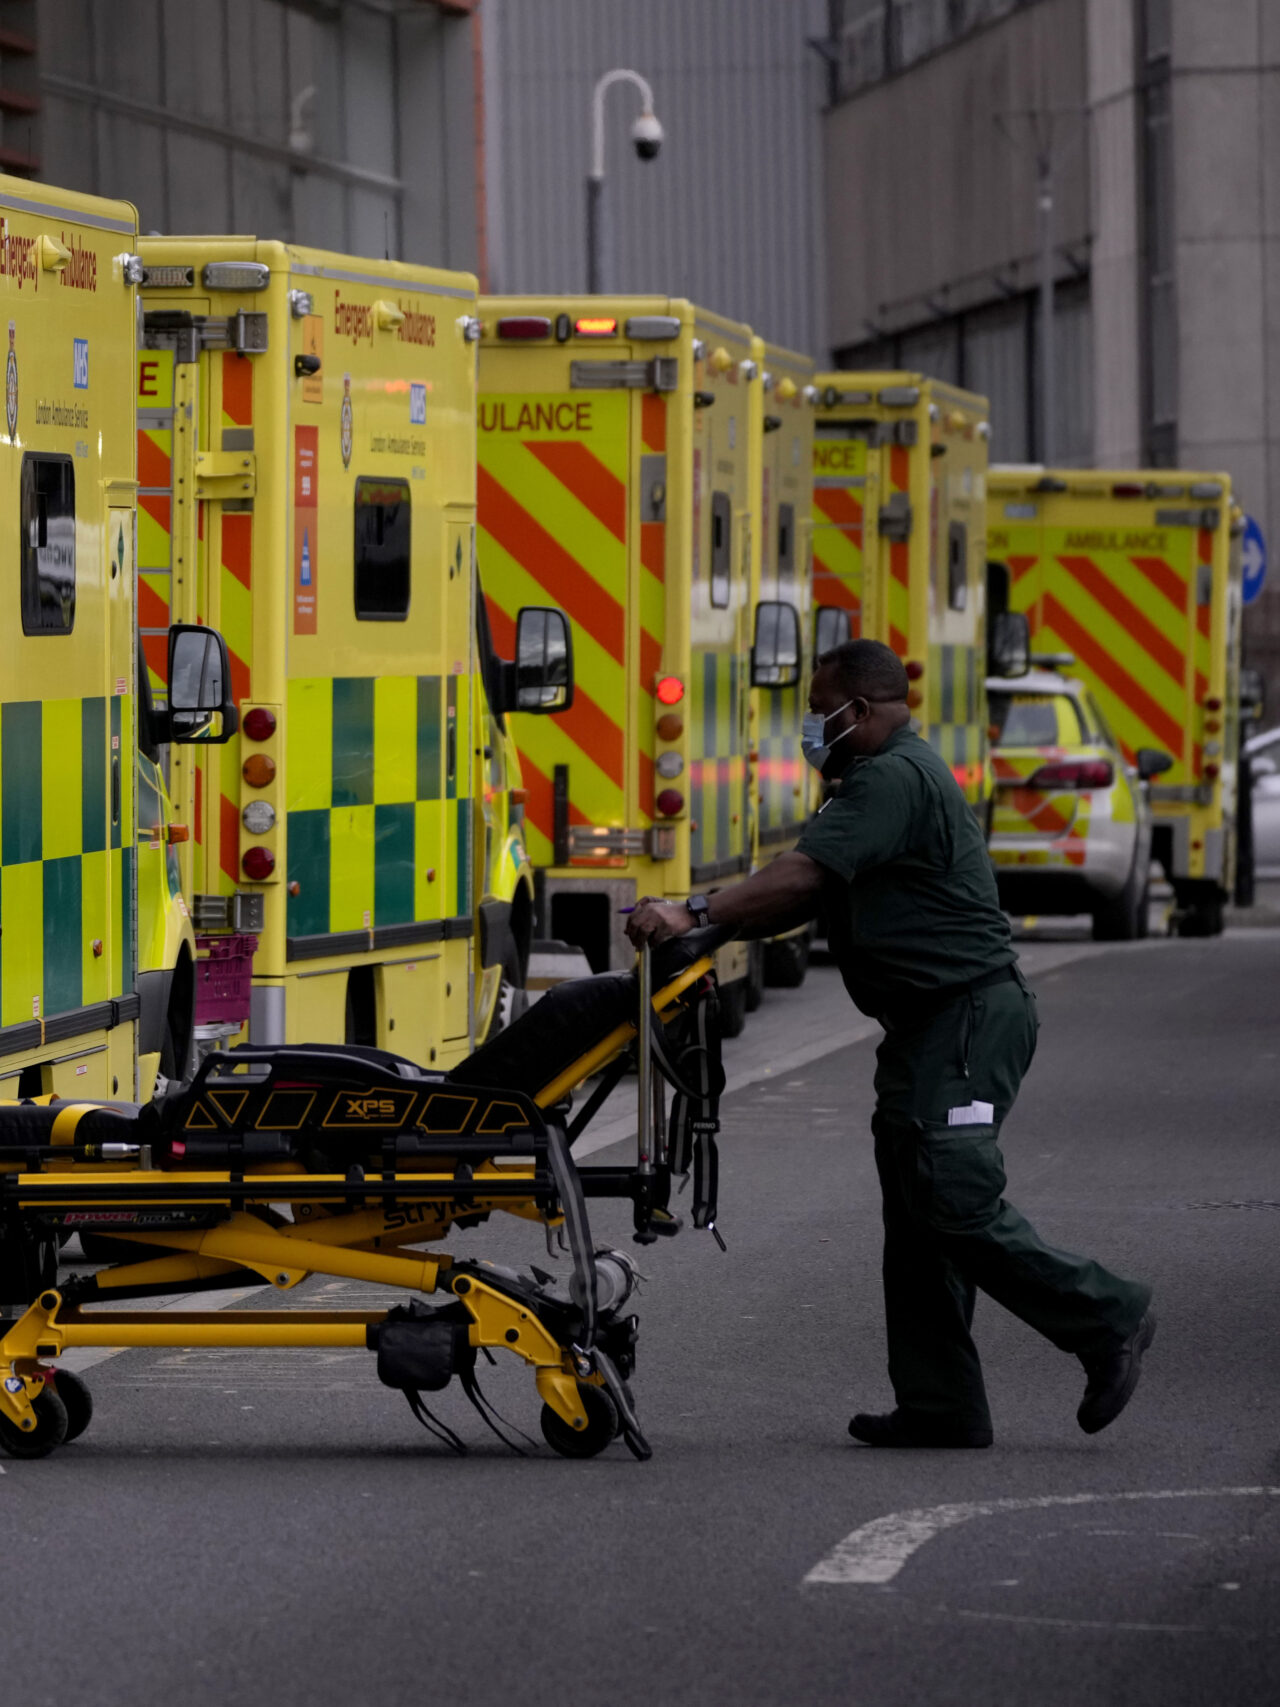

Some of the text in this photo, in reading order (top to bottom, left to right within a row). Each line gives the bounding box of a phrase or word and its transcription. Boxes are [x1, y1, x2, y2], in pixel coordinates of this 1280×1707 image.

[480, 402, 592, 432] ULANCE
[812, 446, 857, 469] NCE
[1064, 531, 1168, 551] AMBULANCE
[347, 1099, 396, 1119] XPS
[693, 1122, 716, 1130] FERNO
